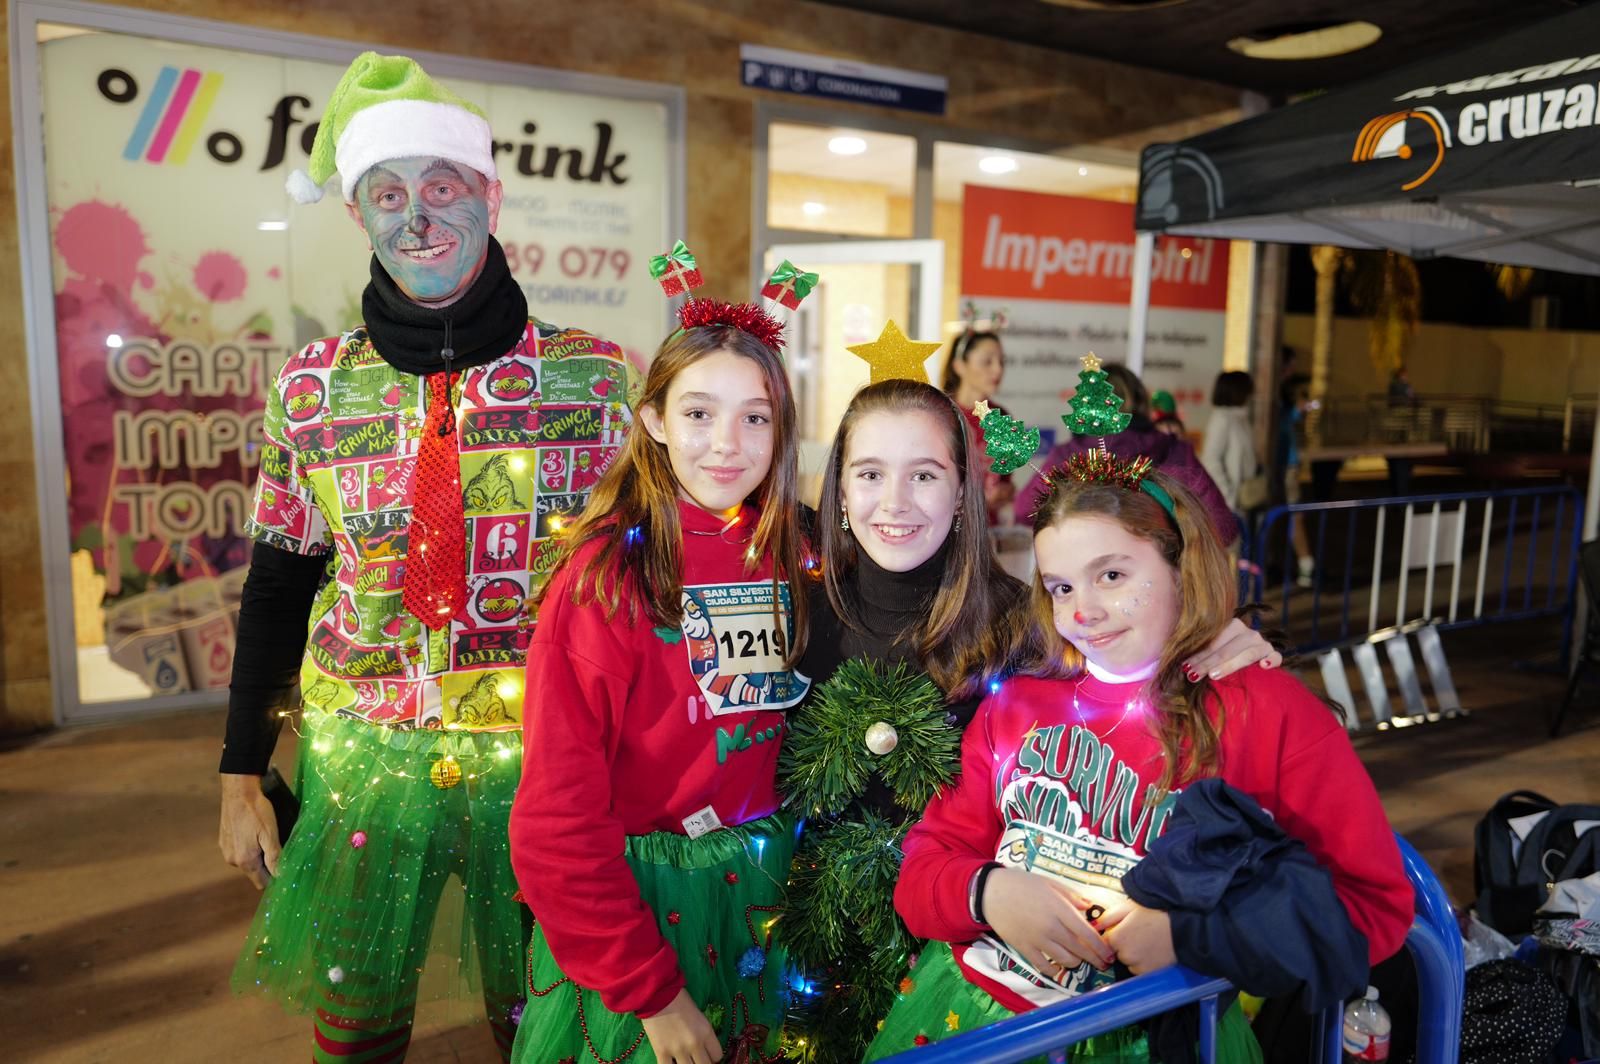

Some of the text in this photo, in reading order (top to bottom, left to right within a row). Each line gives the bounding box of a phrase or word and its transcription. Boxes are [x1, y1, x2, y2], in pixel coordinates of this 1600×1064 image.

[1458, 81, 1600, 146] cruza
[337, 348, 382, 371] GRINC
[543, 339, 593, 362] GRINCH
[108, 337, 291, 397] CART
[476, 413, 513, 430] 12
[543, 407, 593, 440] GRINCH
[574, 418, 603, 438] MAS
[336, 419, 386, 457] GRINCH
[367, 430, 399, 453] MAS
[464, 428, 522, 447] DAYS
[115, 479, 262, 541] TON
[487, 522, 518, 560] 6
[533, 546, 563, 575] GRIN
[703, 589, 728, 598] SAN
[705, 597, 739, 606] CIUDAD
[741, 596, 753, 604] DE
[469, 635, 501, 650] 12
[719, 628, 786, 659] 1219
[345, 650, 388, 676] GRINCH
[458, 649, 512, 667] DAYS
[1038, 846, 1085, 869] CIUDAD
[1087, 862, 1104, 873] DE
[1041, 835, 1138, 870] SAN SILVEST
